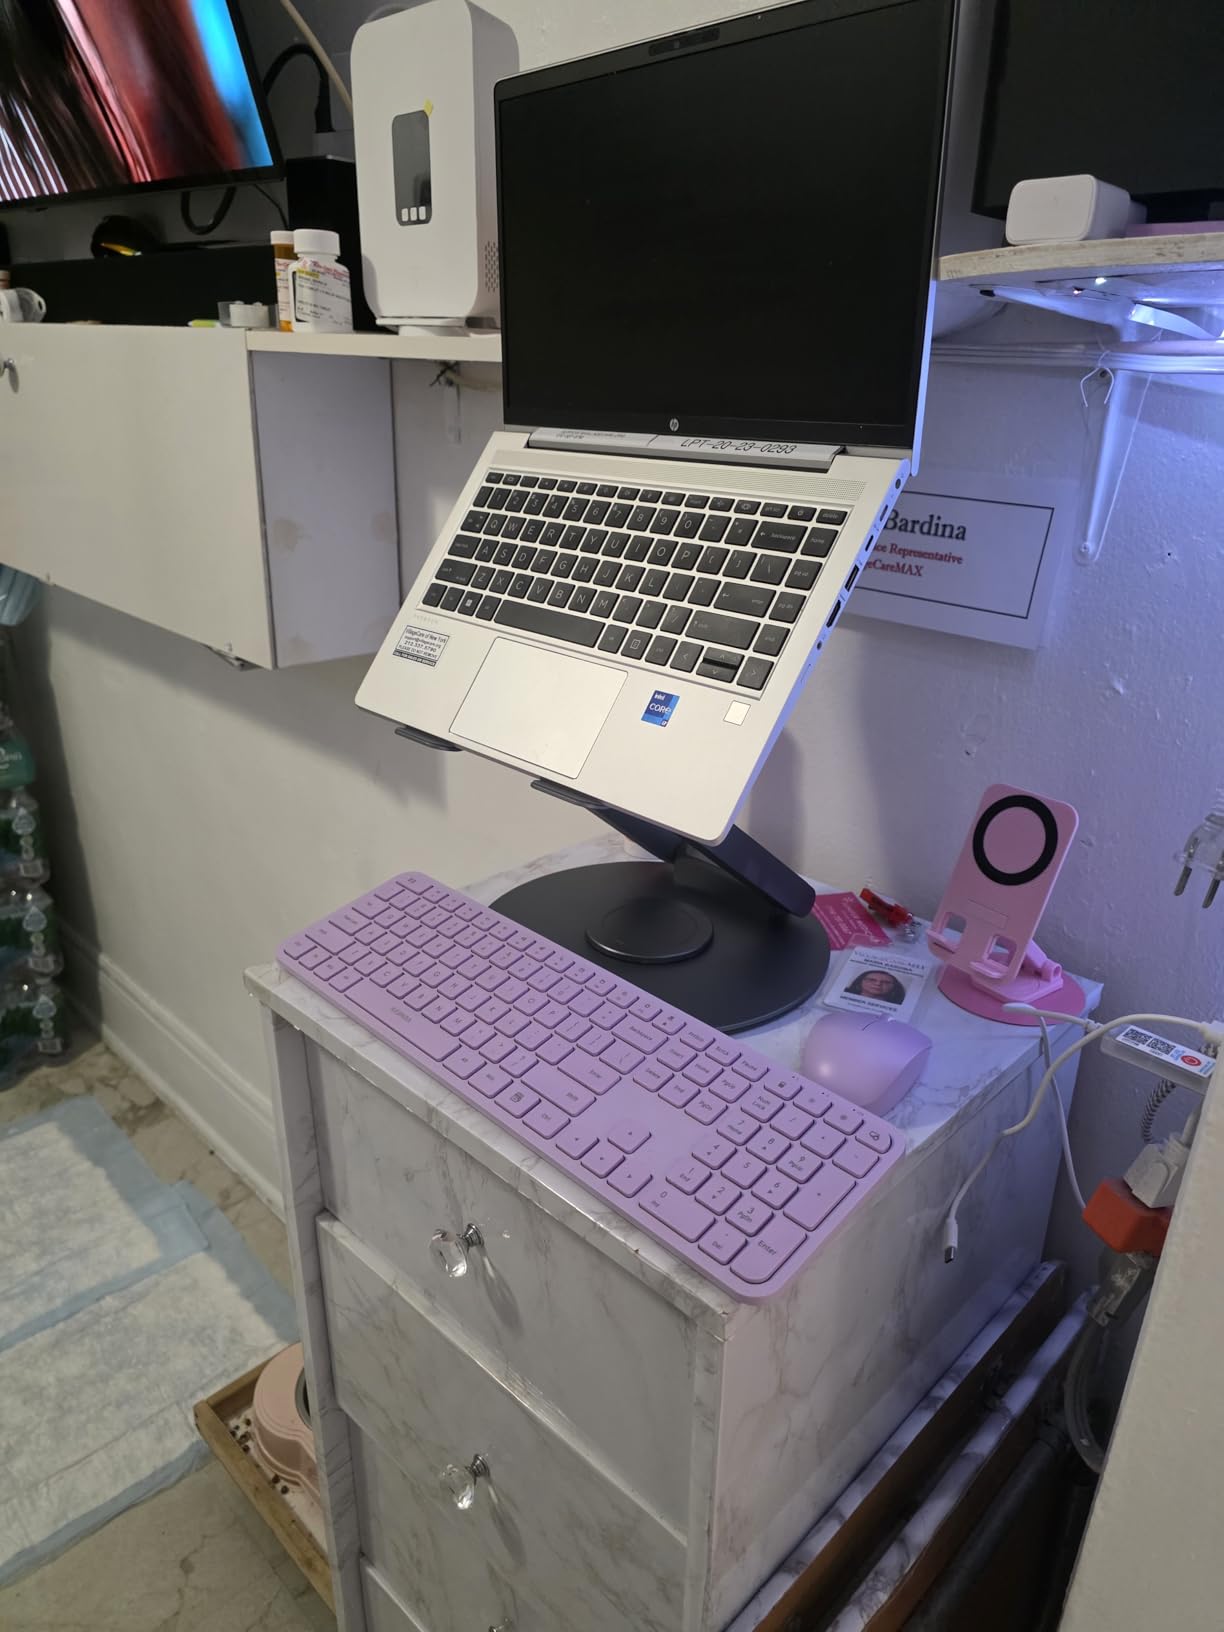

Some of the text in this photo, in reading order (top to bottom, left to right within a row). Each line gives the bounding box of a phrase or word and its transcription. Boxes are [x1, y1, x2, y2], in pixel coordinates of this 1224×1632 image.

[680, 438, 797, 454] LPT-20-23-0293
[883, 509, 967, 542] Bardina
[889, 543, 963, 564] Representative
[758, 1240, 777, 1256] Enter
